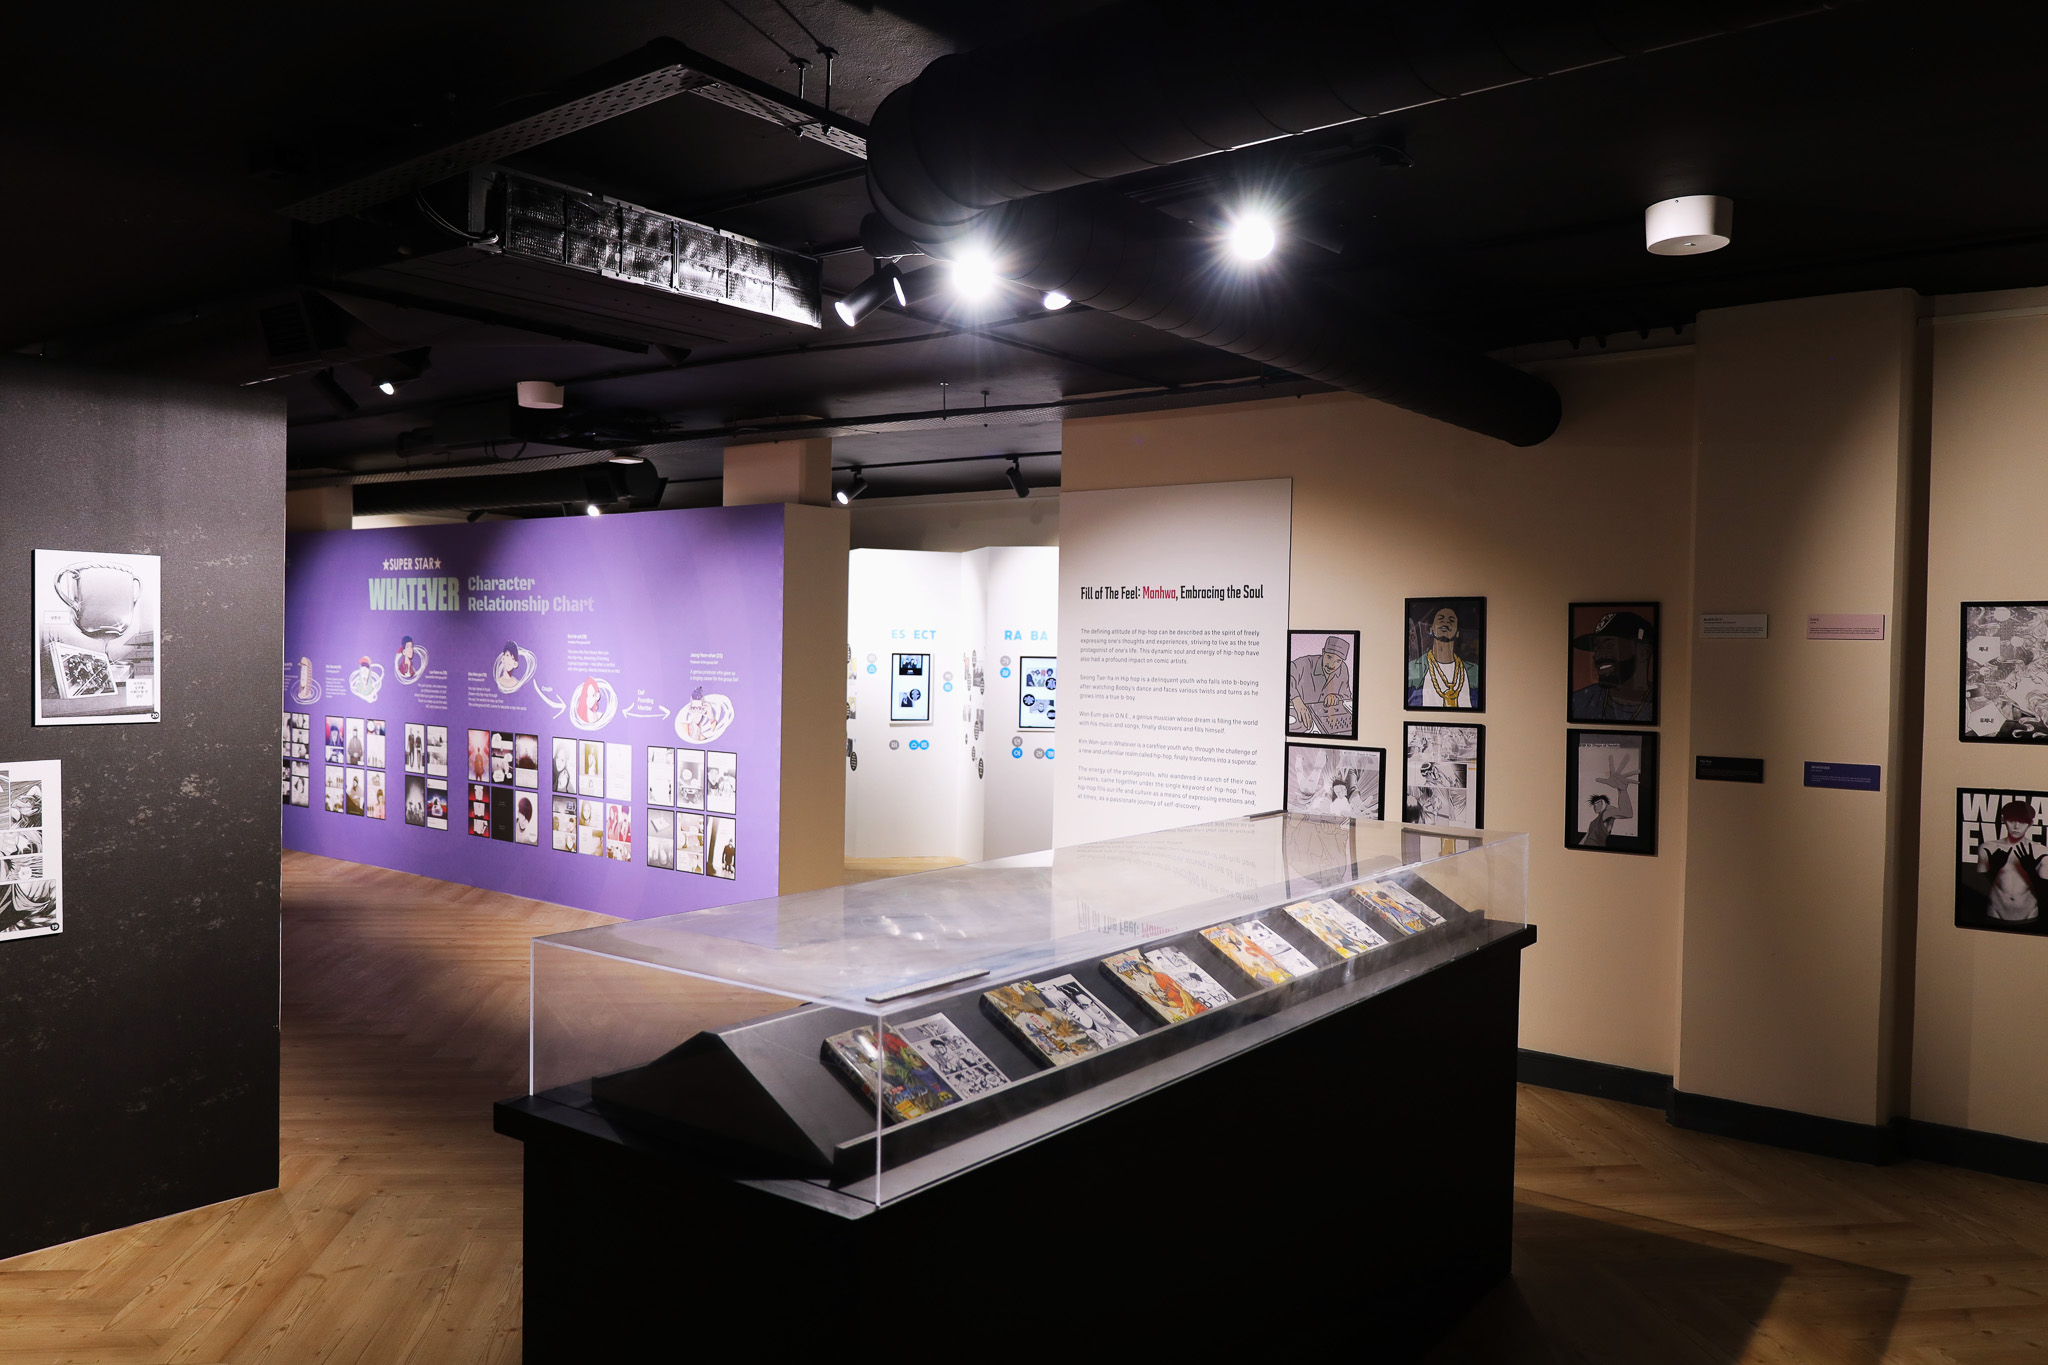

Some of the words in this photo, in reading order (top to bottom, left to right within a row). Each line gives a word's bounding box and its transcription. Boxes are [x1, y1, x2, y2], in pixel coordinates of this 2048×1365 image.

[389, 557, 412, 570] SUPER
[415, 557, 434, 570] STAR
[468, 575, 535, 591] Character
[368, 577, 459, 611] WHATEVER
[1080, 586, 1093, 600] Fill
[1094, 586, 1103, 600] of
[1105, 586, 1119, 599] The
[1121, 586, 1141, 599] Feel:
[1142, 585, 1178, 601] Manhwa,
[1180, 585, 1225, 601] Embracing
[1227, 585, 1241, 599] the
[1243, 584, 1264, 599] Soul
[468, 595, 549, 615] Relationship
[553, 595, 594, 612] Chart
